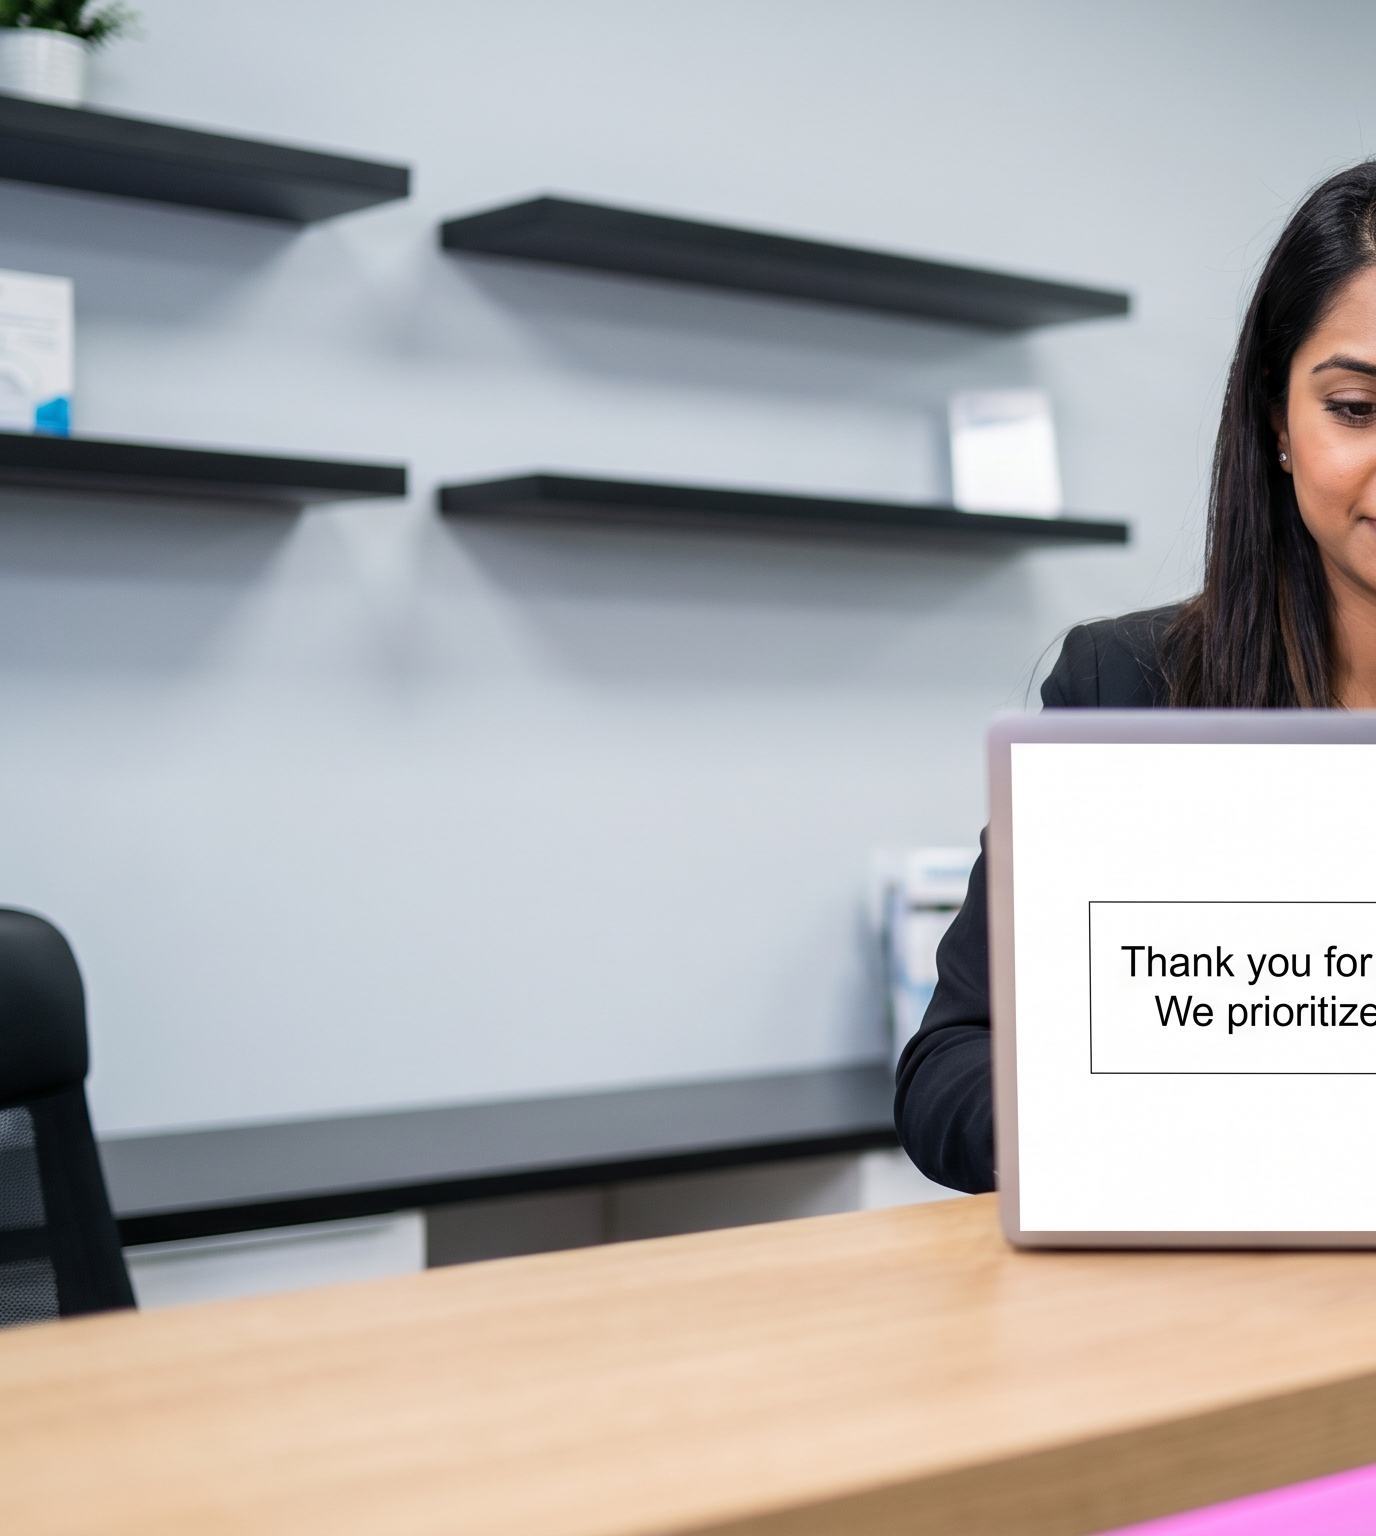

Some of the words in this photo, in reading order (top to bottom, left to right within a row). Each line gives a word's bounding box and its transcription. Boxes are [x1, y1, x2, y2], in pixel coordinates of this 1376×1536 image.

[1120, 945, 1235, 978] Thank
[1246, 953, 1311, 986] you
[1323, 945, 1374, 978] for
[1154, 995, 1214, 1027] We
